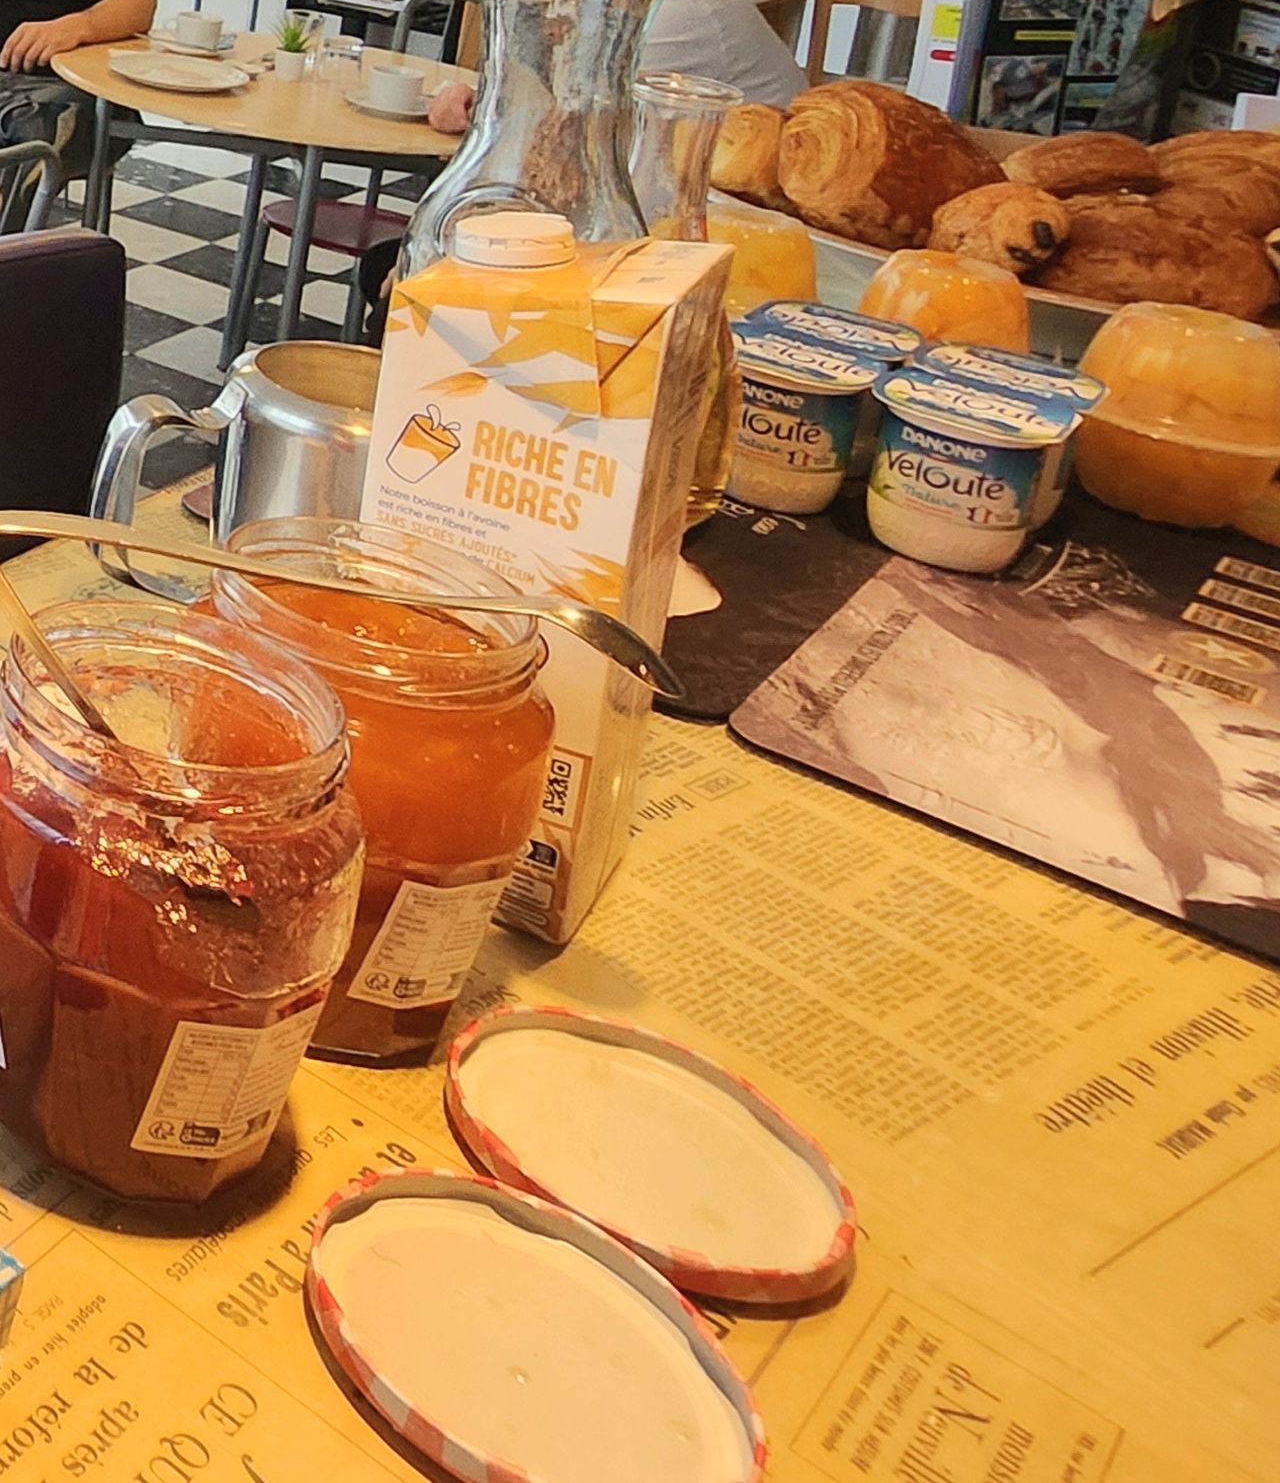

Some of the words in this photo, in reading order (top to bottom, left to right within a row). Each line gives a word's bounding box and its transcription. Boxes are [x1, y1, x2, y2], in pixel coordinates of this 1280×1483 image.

[738, 401, 825, 452] louté
[899, 424, 988, 466] DANONE
[467, 418, 569, 482] RICHE
[569, 449, 622, 498] EN
[377, 497, 395, 510] est
[395, 501, 424, 518] riche
[425, 512, 440, 524] en
[440, 515, 474, 534] fibres
[474, 527, 487, 538] et
[379, 484, 411, 502] Notre
[411, 494, 457, 516] boisson
[456, 507, 466, 518] à
[465, 510, 511, 532] l'avoine
[459, 461, 587, 533] FIBRES
[374, 510, 407, 529] SANS
[408, 520, 457, 545] SUCRES
[484, 559, 536, 586] CALCIUM
[630, 788, 698, 827] Enfin
[1145, 1005, 1260, 1072] illusion
[1112, 1053, 1172, 1088] et
[1025, 1072, 1148, 1144] théâtre
[311, 1120, 348, 1158] Les
[65, 1290, 109, 1333] adoptée
[213, 1251, 304, 1343] Paris
[22, 1354, 40, 1372] en
[40, 1331, 69, 1360] hier
[104, 1316, 153, 1364] de
[68, 1352, 113, 1397] la
[937, 1358, 1006, 1414] de
[194, 1374, 264, 1443] CE
[881, 1382, 996, 1483] Neuville
[51, 1392, 148, 1483] après
